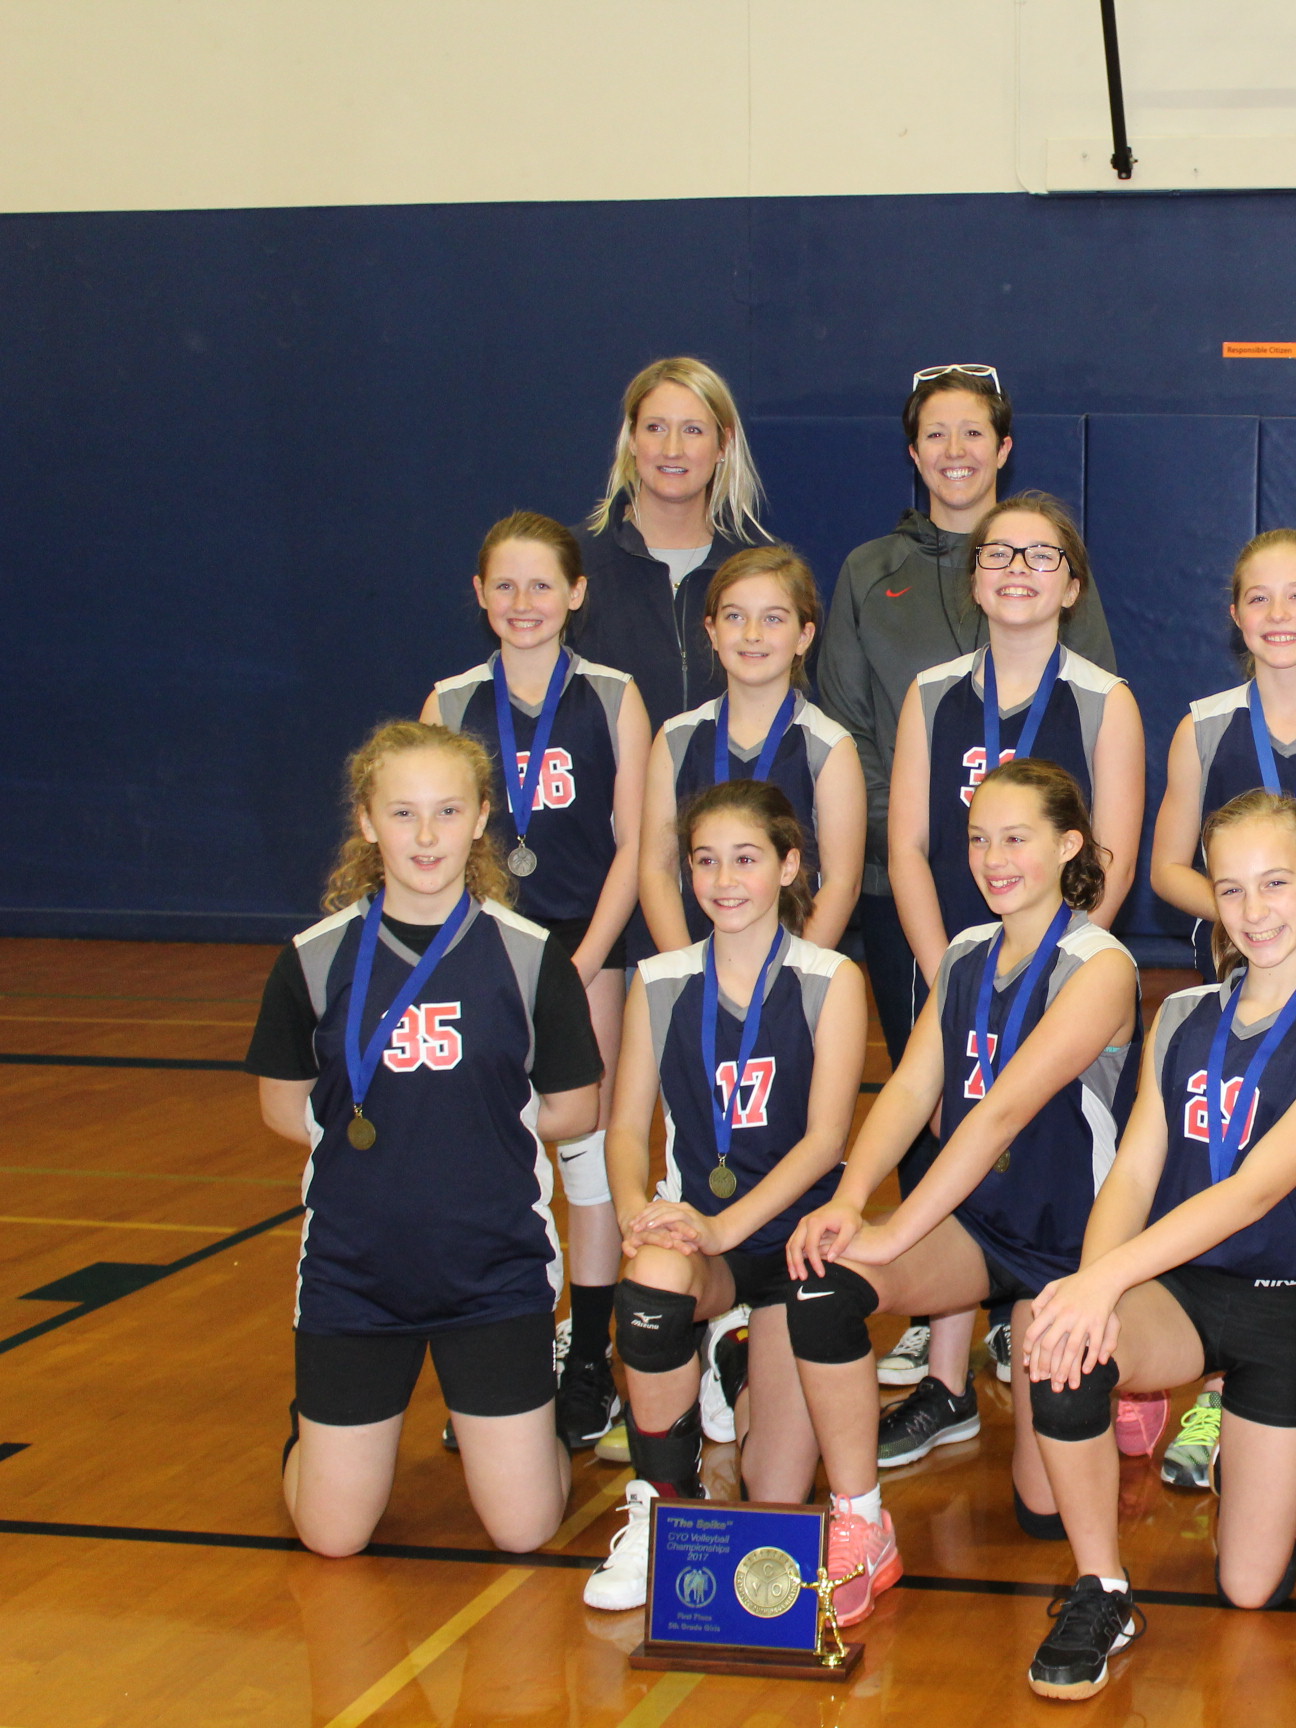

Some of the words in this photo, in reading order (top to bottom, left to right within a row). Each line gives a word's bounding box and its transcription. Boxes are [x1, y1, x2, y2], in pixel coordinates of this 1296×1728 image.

[1227, 346, 1267, 354] Responsible
[1269, 346, 1293, 354] Citizen
[960, 746, 1017, 808] 3
[381, 1001, 462, 1073] 35
[963, 1029, 999, 1100] 7
[715, 1056, 776, 1130] 17
[667, 1541, 730, 1554] Championships
[668, 1532, 689, 1541] CYO
[691, 1533, 730, 1544] Volleyball
[687, 1552, 709, 1561] 2017
